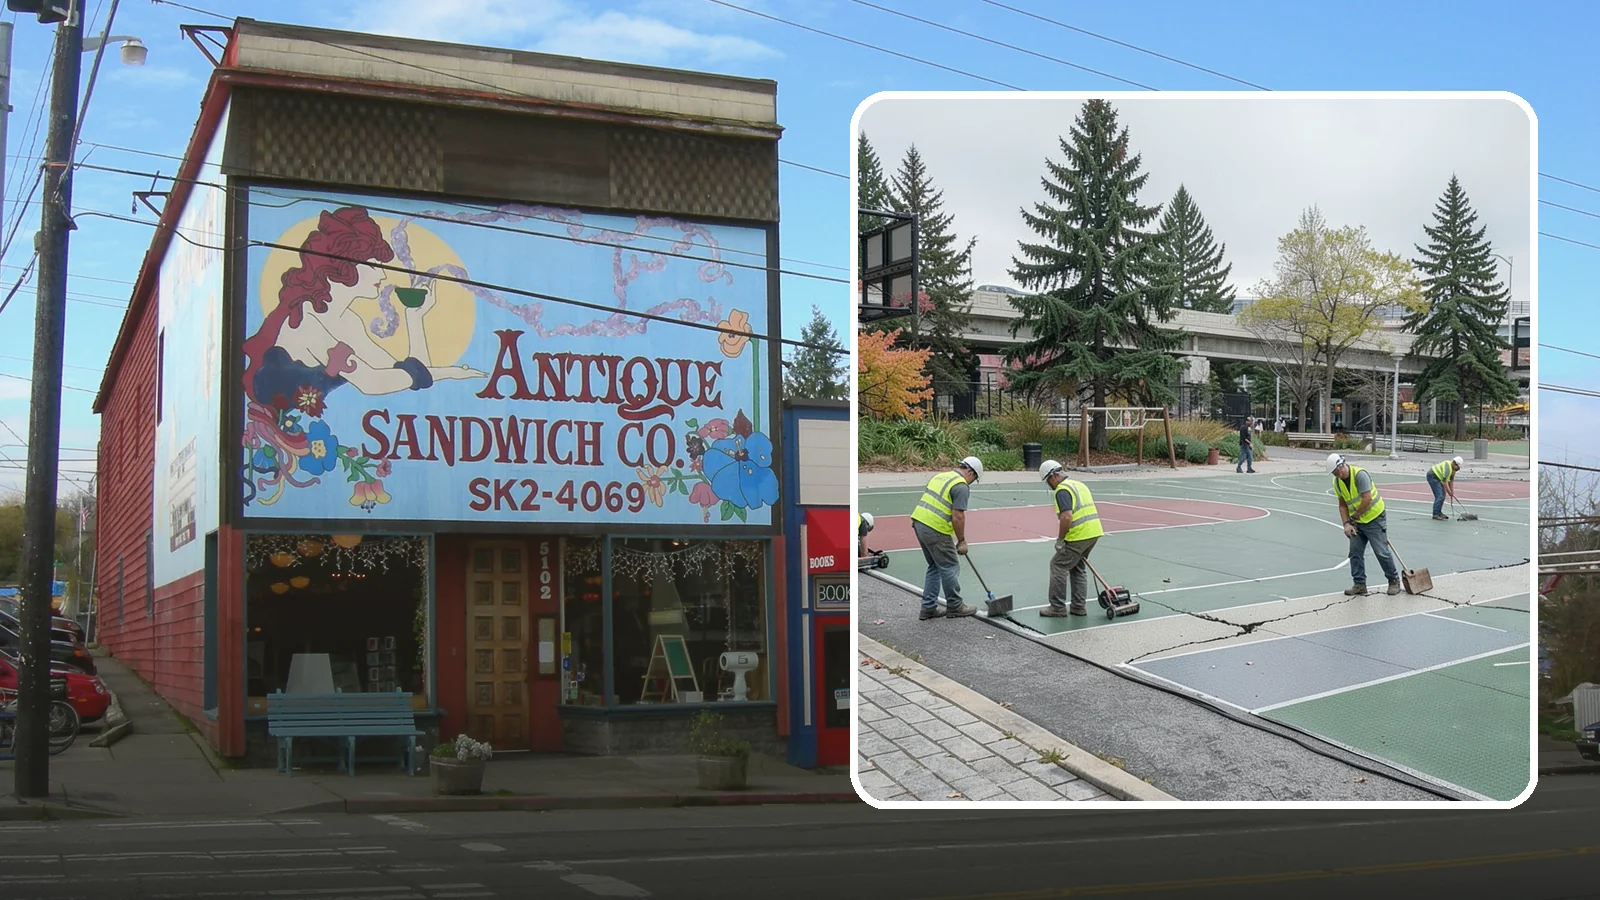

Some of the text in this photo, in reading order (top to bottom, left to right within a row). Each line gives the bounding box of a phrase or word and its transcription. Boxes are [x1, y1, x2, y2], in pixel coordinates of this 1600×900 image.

[477, 329, 724, 421] ANTIQUE
[361, 409, 686, 469] SANDWICH CO.
[468, 477, 647, 513] SK2-4069
[540, 542, 551, 599] 5102
[809, 555, 835, 569] BOOKS
